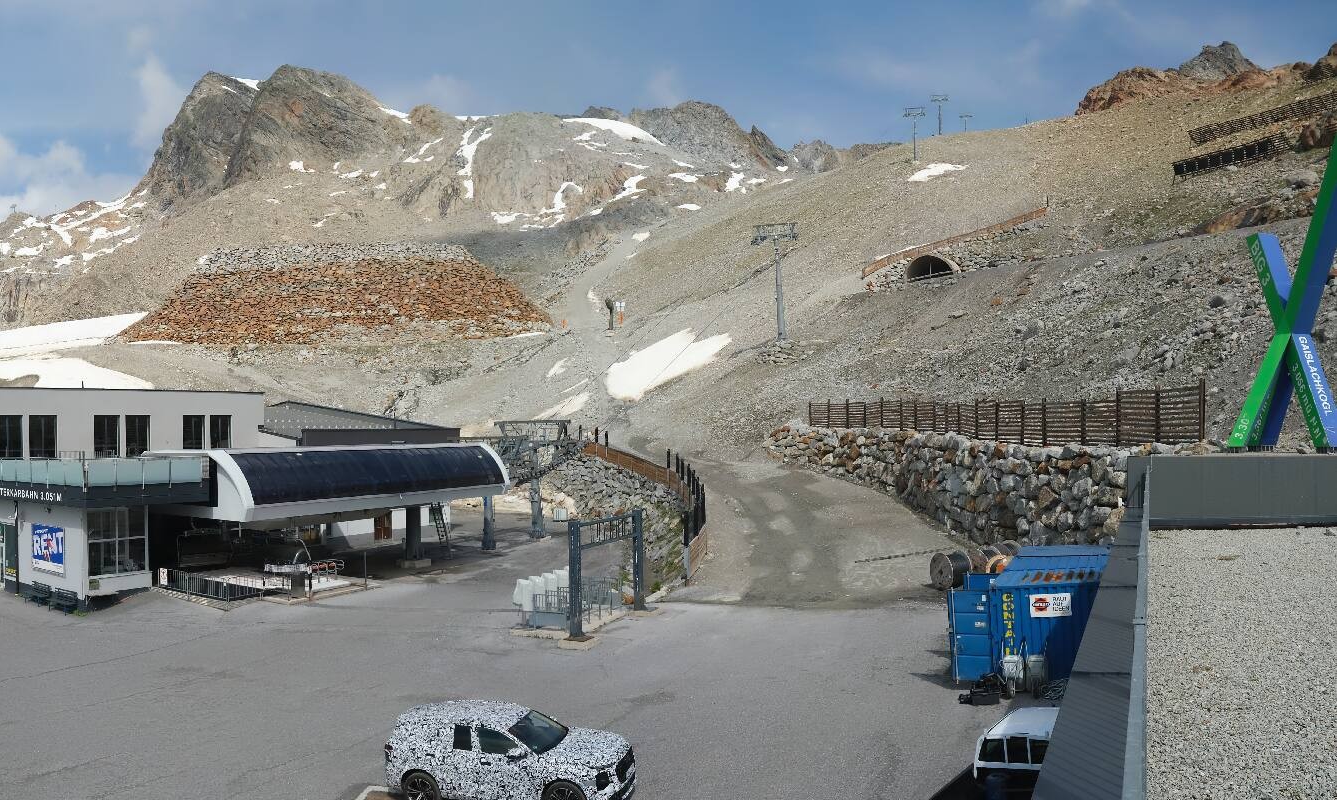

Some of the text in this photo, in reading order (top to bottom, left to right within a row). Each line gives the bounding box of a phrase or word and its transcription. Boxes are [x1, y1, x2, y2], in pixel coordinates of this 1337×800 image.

[1250, 239, 1266, 272] BIG
[1298, 335, 1333, 417] GAISLACHKOGL
[32, 532, 64, 556] RENT
